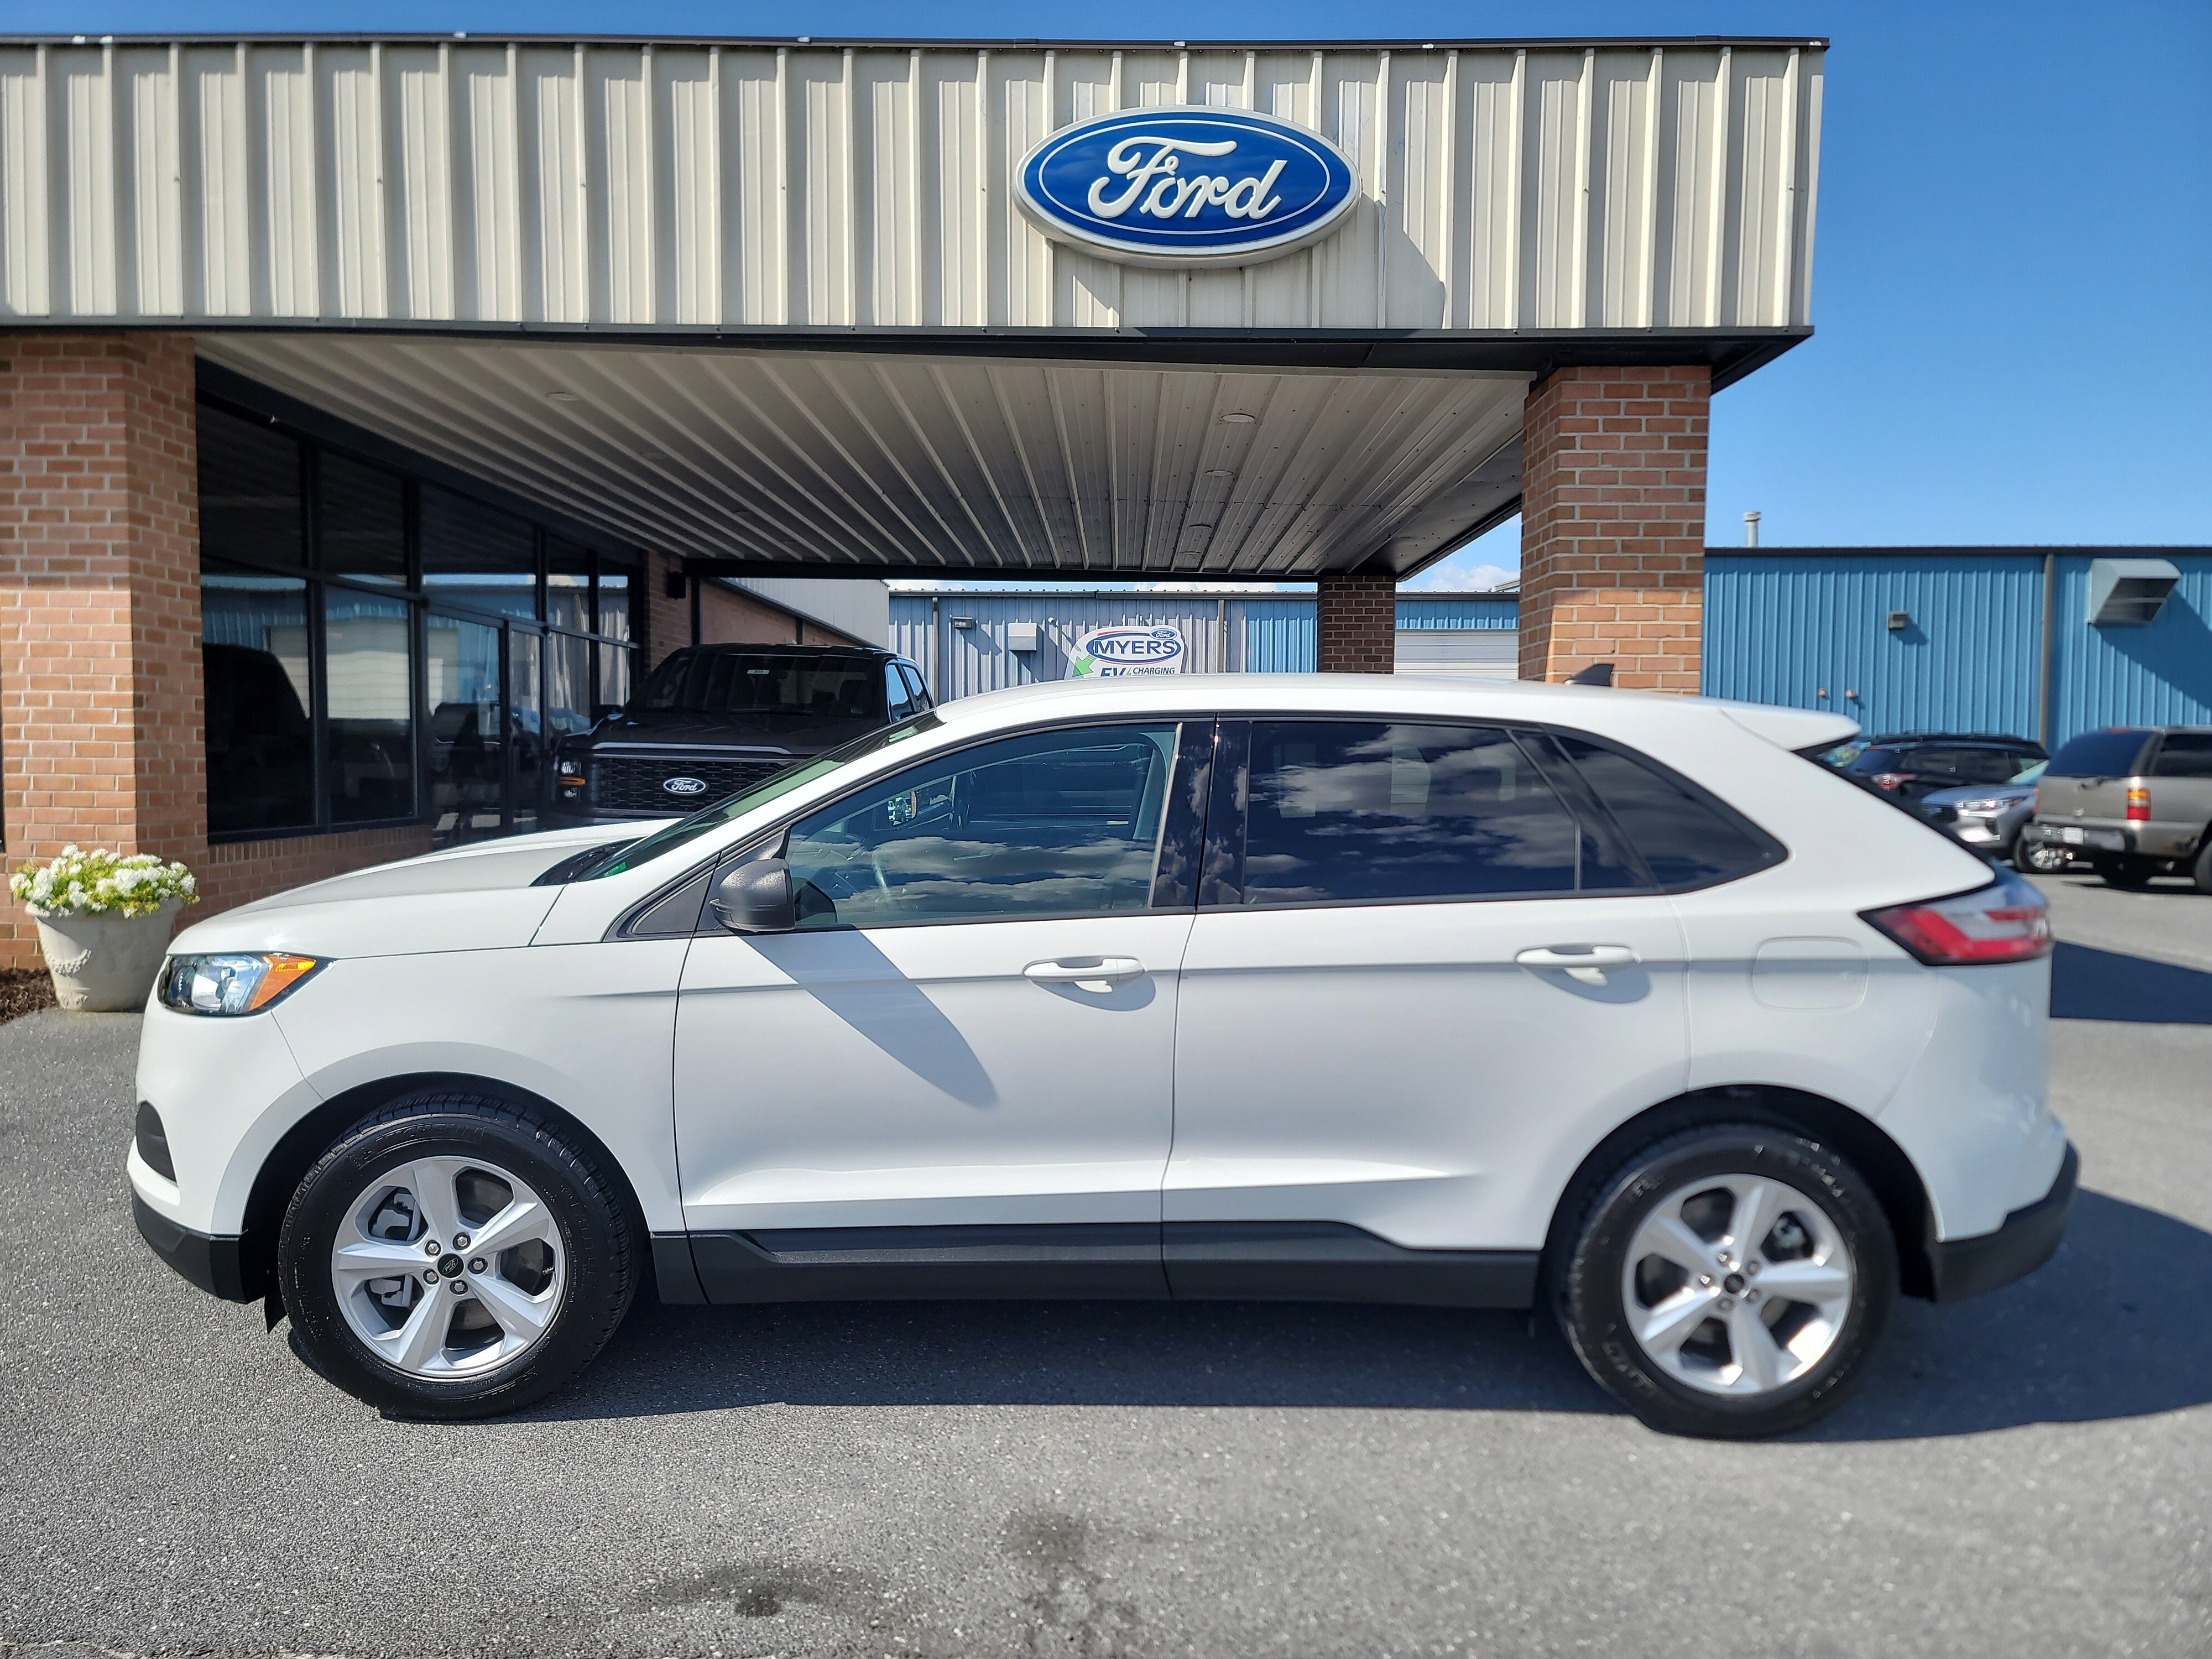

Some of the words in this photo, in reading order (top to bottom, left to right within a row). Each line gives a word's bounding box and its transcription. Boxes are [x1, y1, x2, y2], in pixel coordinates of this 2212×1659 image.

[1088, 137, 1288, 220] Ford
[1155, 629, 1171, 638] Ford
[1094, 640, 1175, 654] MYERS
[1100, 667, 1126, 676] EV
[671, 780, 698, 791] Ford
